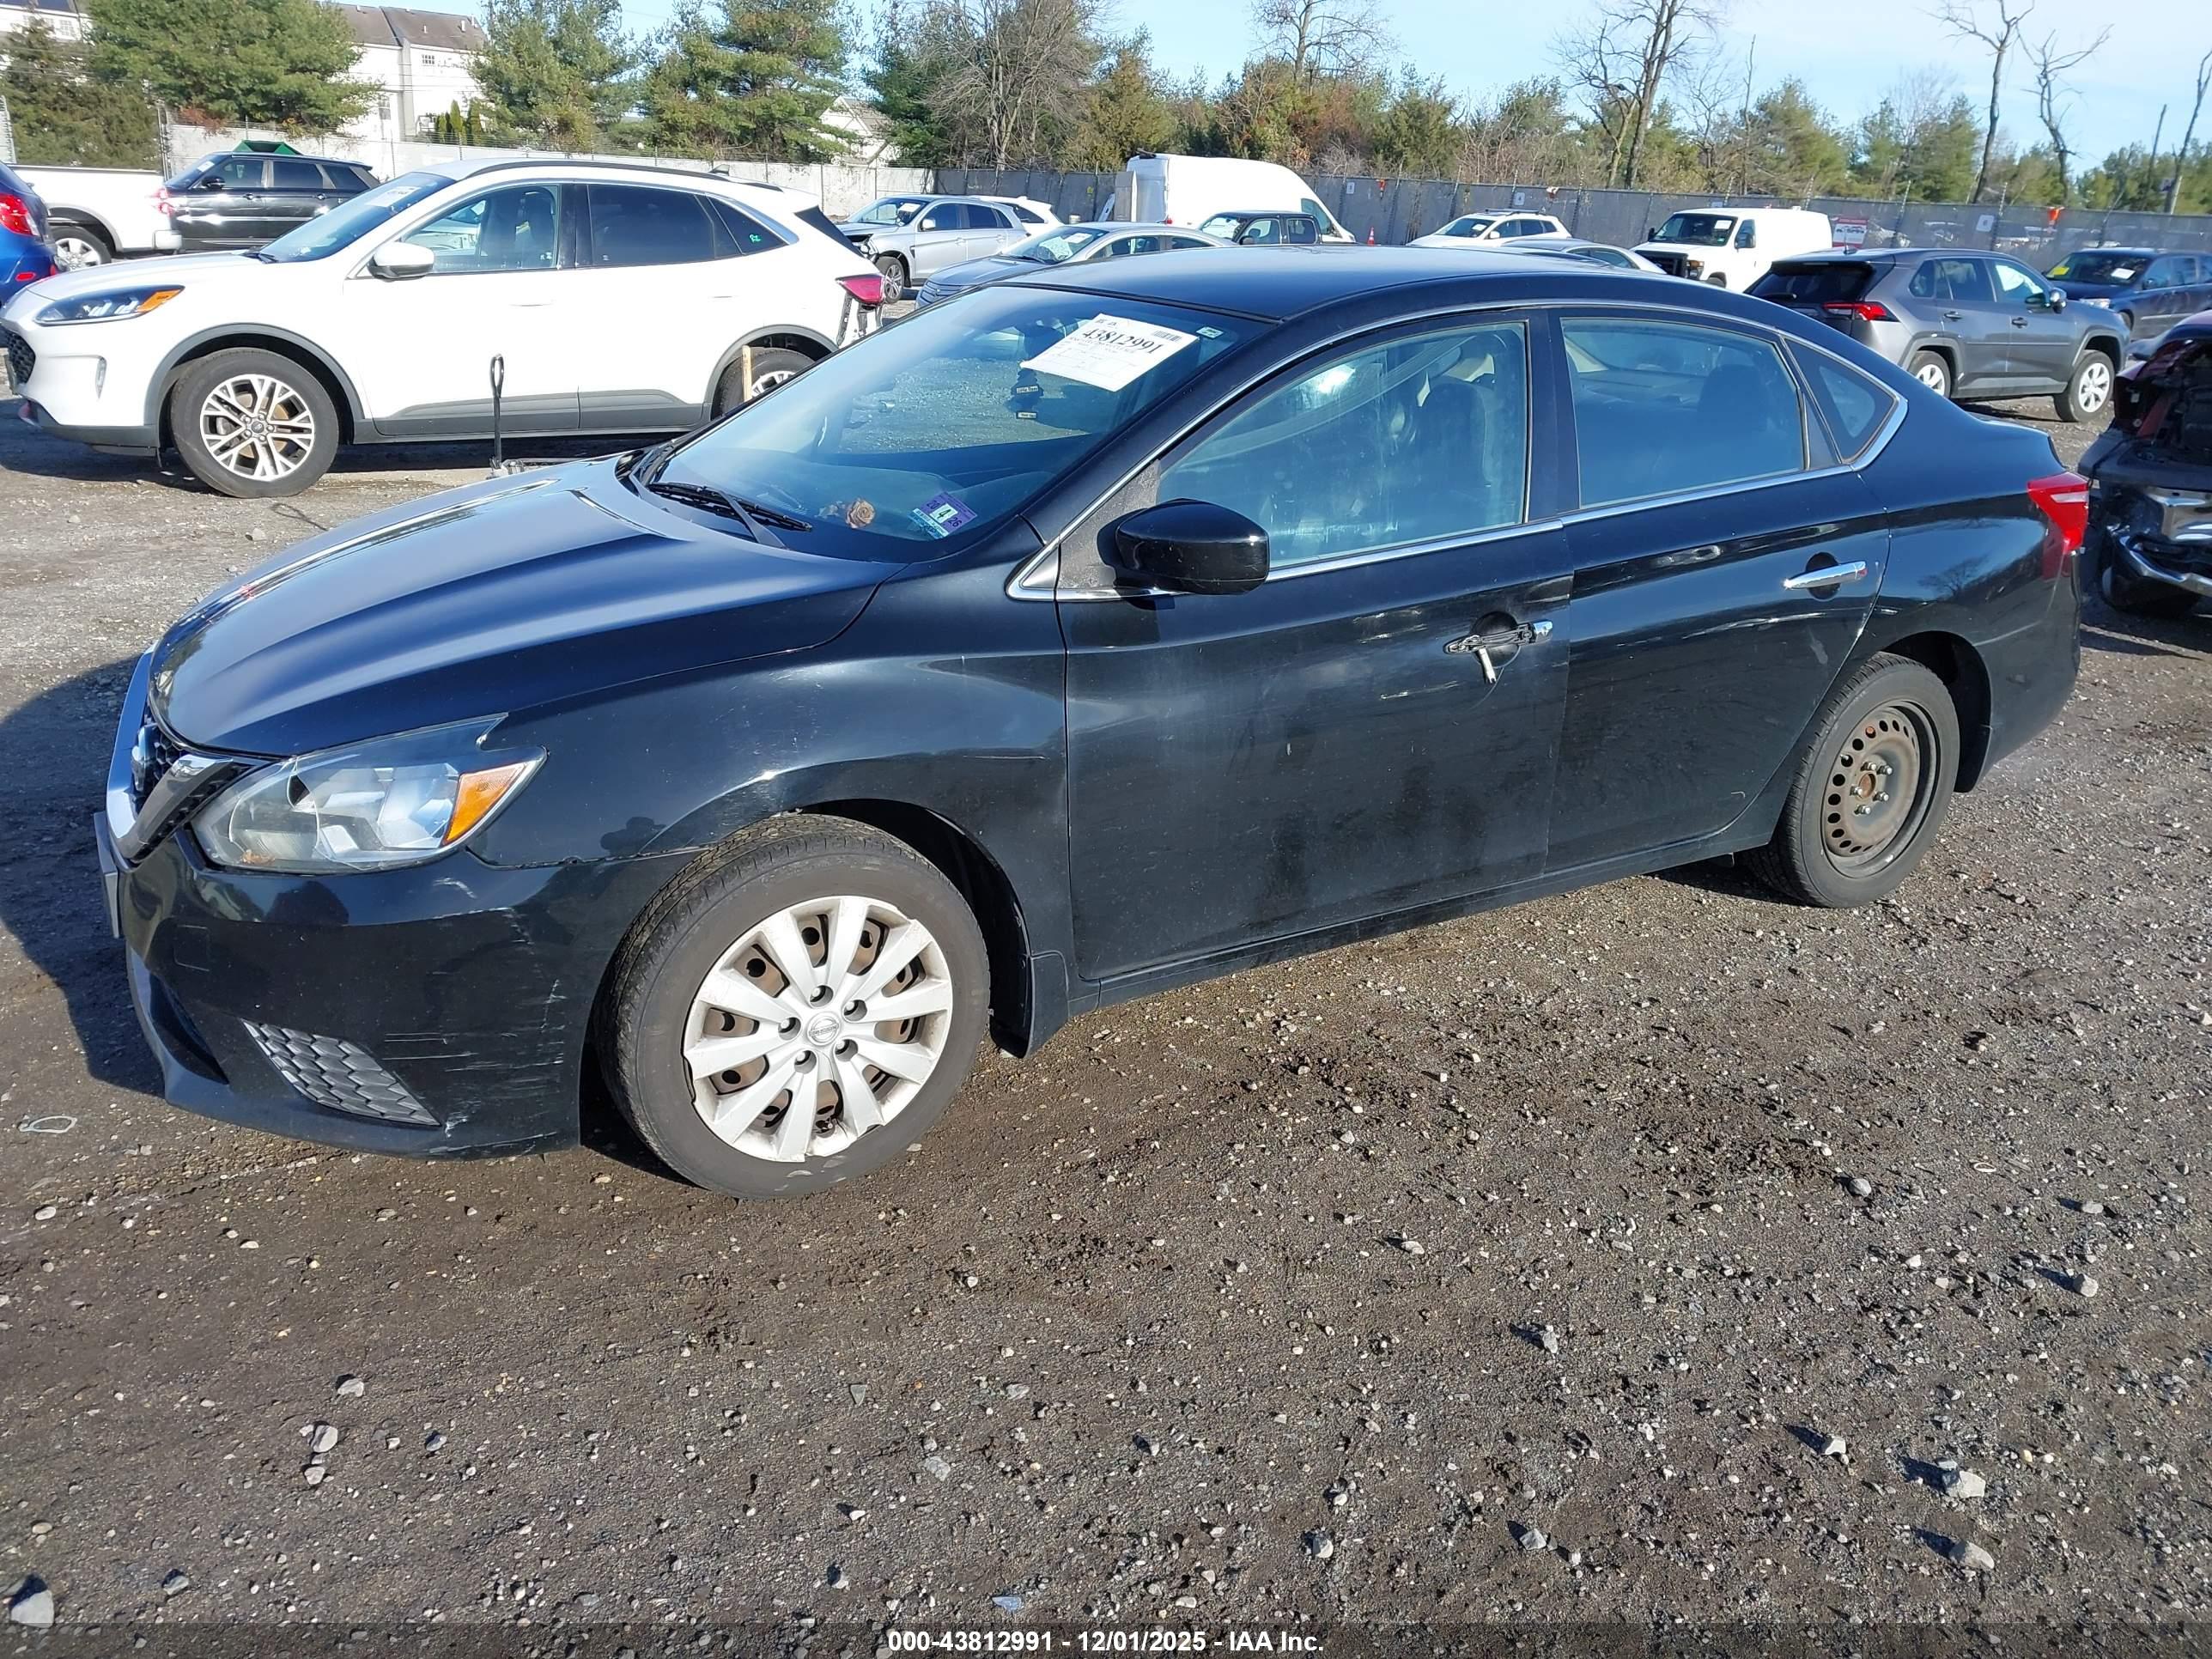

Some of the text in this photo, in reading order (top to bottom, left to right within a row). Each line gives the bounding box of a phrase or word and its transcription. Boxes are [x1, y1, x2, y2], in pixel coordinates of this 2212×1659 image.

[1082, 328, 1164, 354] 43812991
[937, 508, 951, 520] 4
[947, 516, 963, 527] 26
